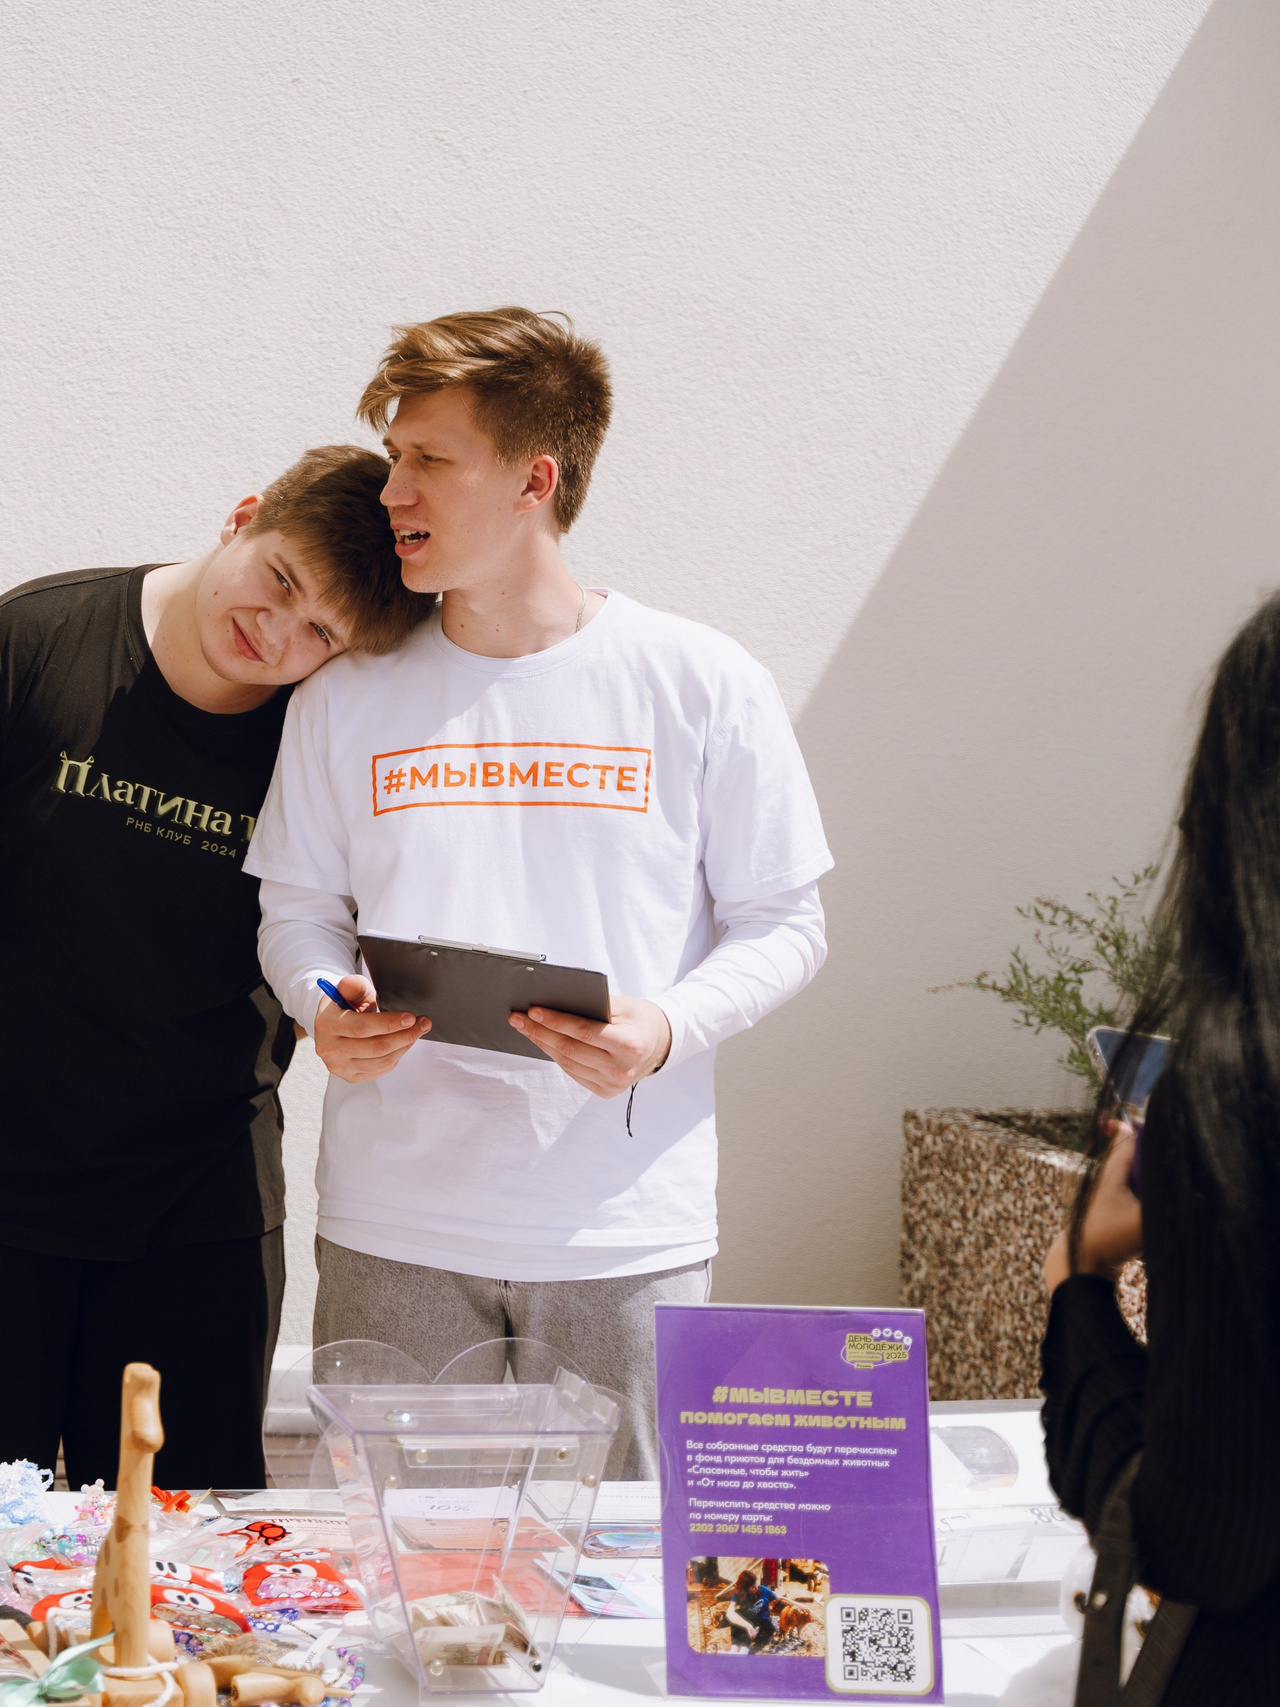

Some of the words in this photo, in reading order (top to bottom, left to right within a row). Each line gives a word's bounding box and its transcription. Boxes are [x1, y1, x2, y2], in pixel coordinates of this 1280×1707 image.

[383, 761, 638, 795] #МЫВМЕСТЕ
[51, 751, 233, 837] Платина
[126, 817, 153, 834] РНБ
[156, 826, 192, 846] КЛУБ
[201, 840, 237, 858] 2024
[848, 1335, 872, 1343] ДЕНЬ
[848, 1342, 902, 1351] МОЛОДЁЖИ
[885, 1352, 907, 1360] 2025
[712, 1386, 873, 1407] #МЫВМЕСТЕ
[680, 1411, 790, 1427] помогаем
[793, 1414, 907, 1430] животным
[686, 1440, 703, 1449] Все
[706, 1442, 759, 1451] собранные
[762, 1444, 803, 1453] средства
[806, 1444, 832, 1454] будут
[835, 1446, 897, 1455] перечислены
[695, 1454, 722, 1464] фонд
[725, 1455, 765, 1464] приютов
[768, 1457, 784, 1465] для
[787, 1456, 840, 1466] бездомных
[843, 1459, 890, 1467] животных
[688, 1466, 748, 1476] «Спасенные,
[750, 1467, 778, 1476] чтобы
[697, 1478, 715, 1487] «От
[743, 1481, 754, 1489] до
[689, 1498, 750, 1509] Перечислить
[753, 1501, 795, 1511] средства
[704, 1513, 739, 1522] номеру
[742, 1513, 773, 1522] карты:
[690, 1524, 714, 1532] 2202
[716, 1524, 739, 1533] 2067
[742, 1525, 763, 1533] 1455
[765, 1526, 787, 1534] 1863
